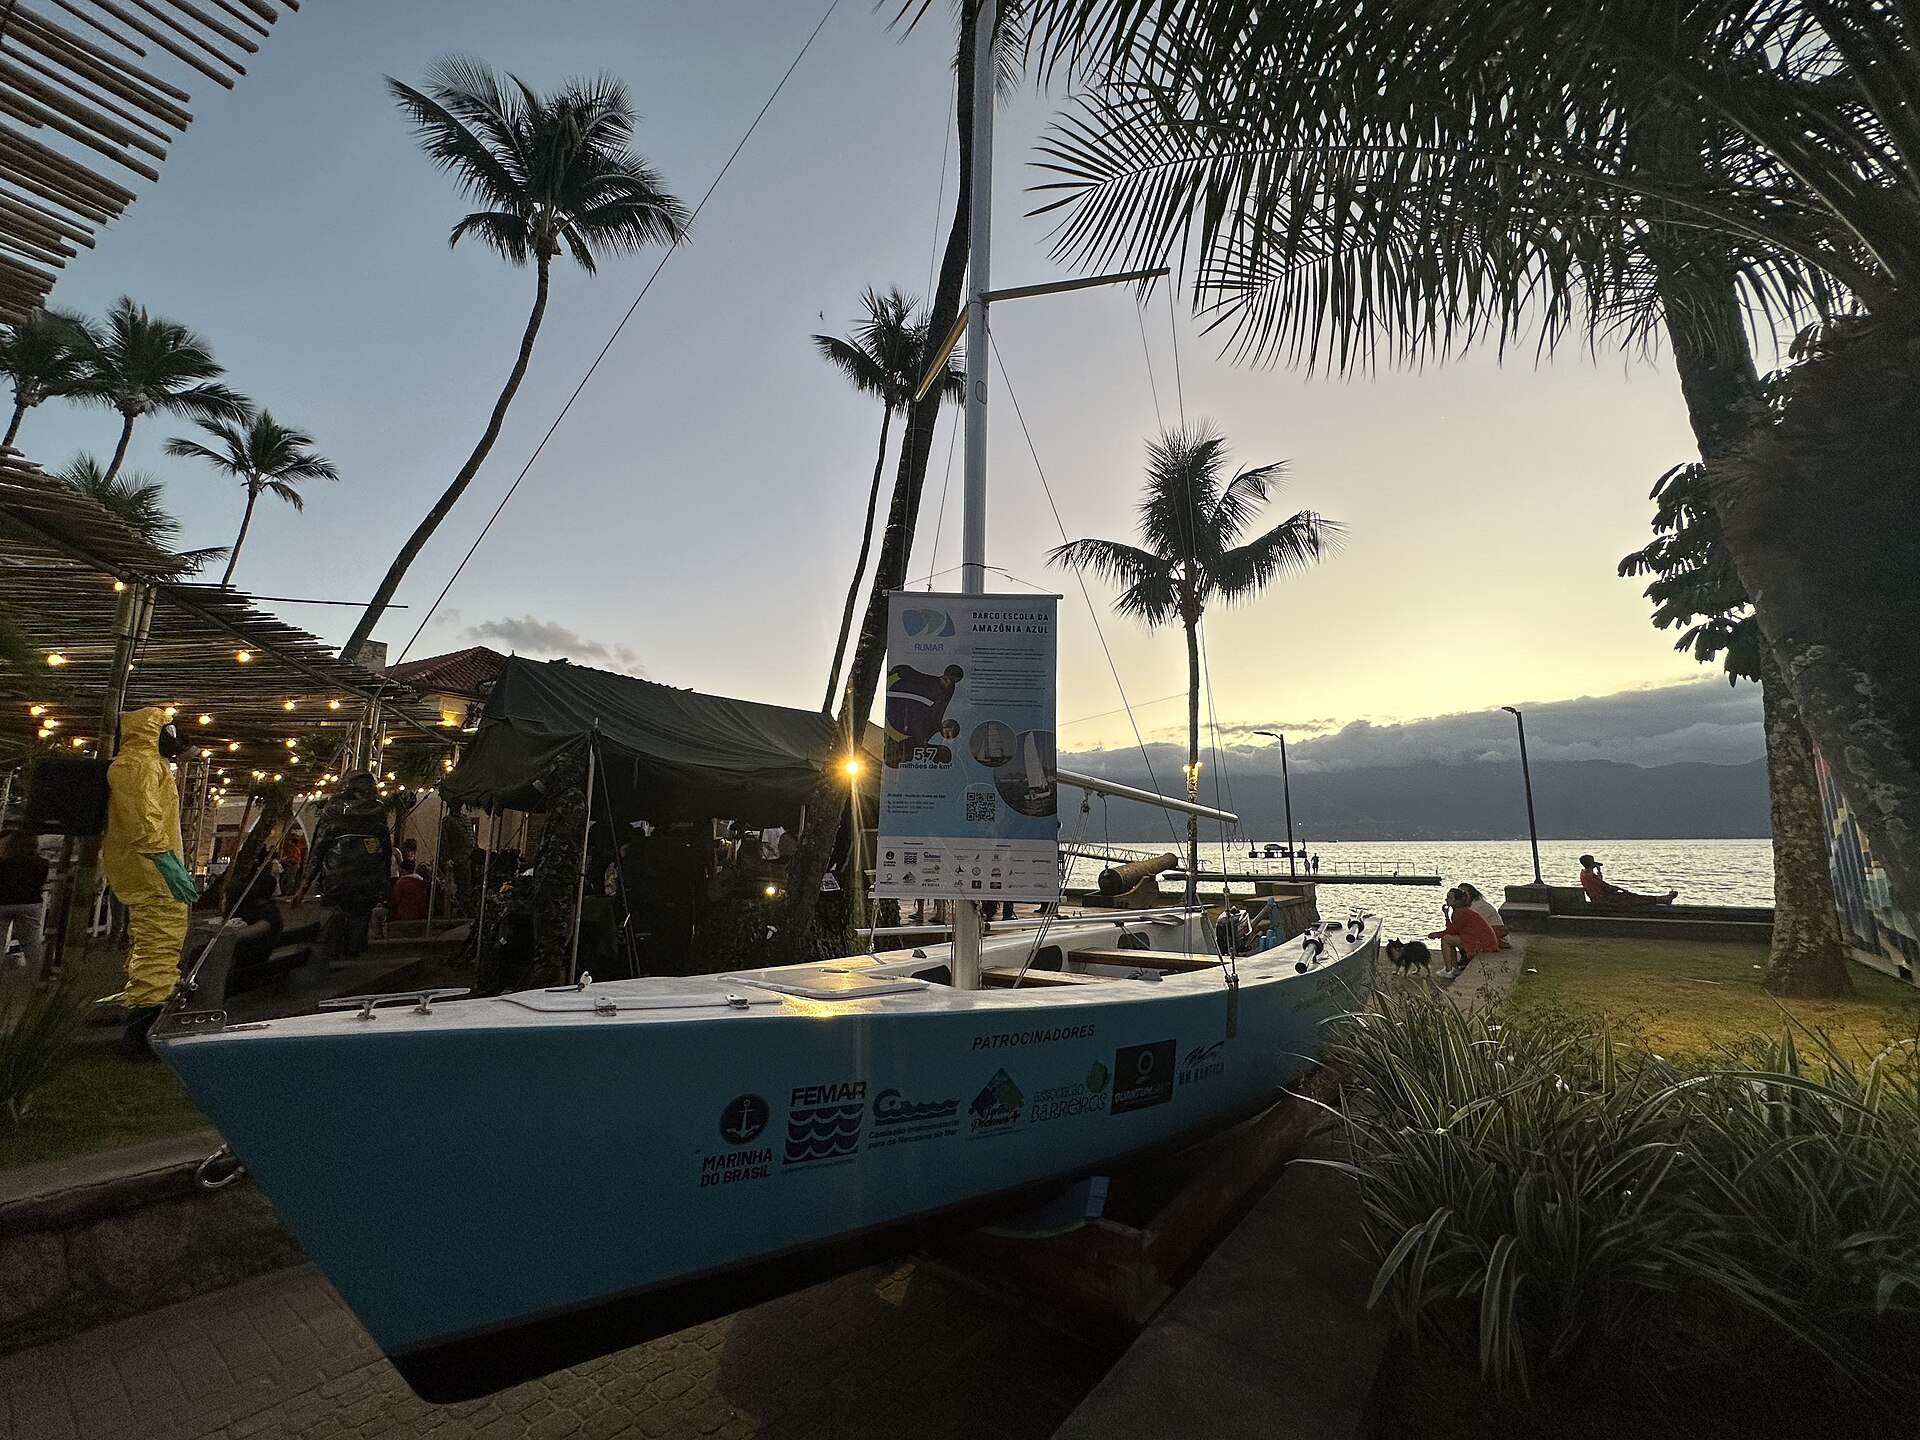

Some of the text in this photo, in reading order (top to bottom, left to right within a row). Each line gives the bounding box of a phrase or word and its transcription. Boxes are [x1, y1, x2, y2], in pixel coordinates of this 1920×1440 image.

[972, 612, 1049, 621] BARCO ESCOLA DA
[972, 623, 1049, 634] AMAZÔNIA AZUL
[914, 643, 944, 652] RUMAR
[972, 1024, 1096, 1050] PATROCINADORES
[791, 1081, 867, 1107] FEMAR
[703, 1148, 773, 1172] MARINHA
[701, 1172, 720, 1187] DO
[723, 1165, 772, 1184] BRASIL
